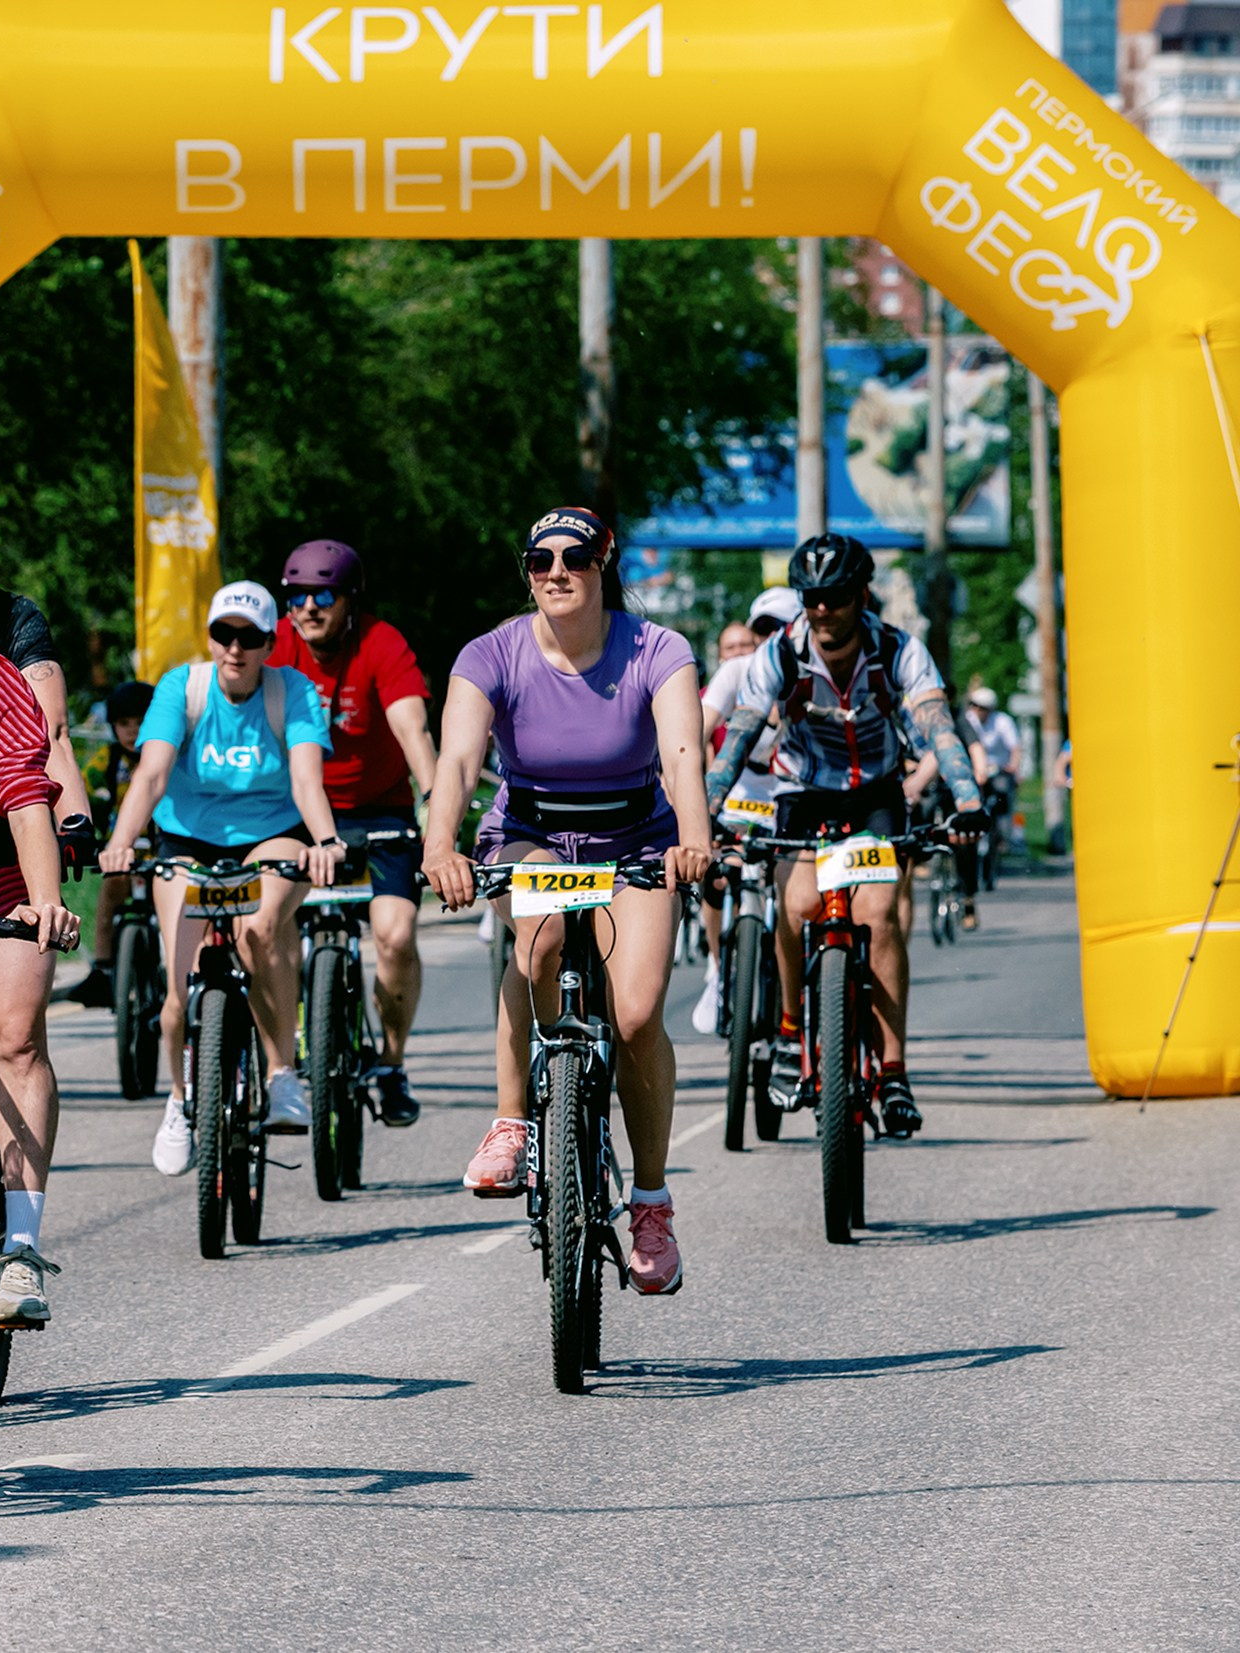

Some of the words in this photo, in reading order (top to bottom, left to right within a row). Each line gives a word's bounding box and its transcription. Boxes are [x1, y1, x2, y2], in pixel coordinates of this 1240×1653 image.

[268, 3, 663, 83] КРУТИ
[175, 139, 246, 213] В
[292, 127, 757, 213] ПЕРМИ!
[962, 106, 1162, 281] ВЕЛО
[1015, 77, 1198, 236] ПЕРМСКИЙ
[528, 874, 596, 893] 1204
